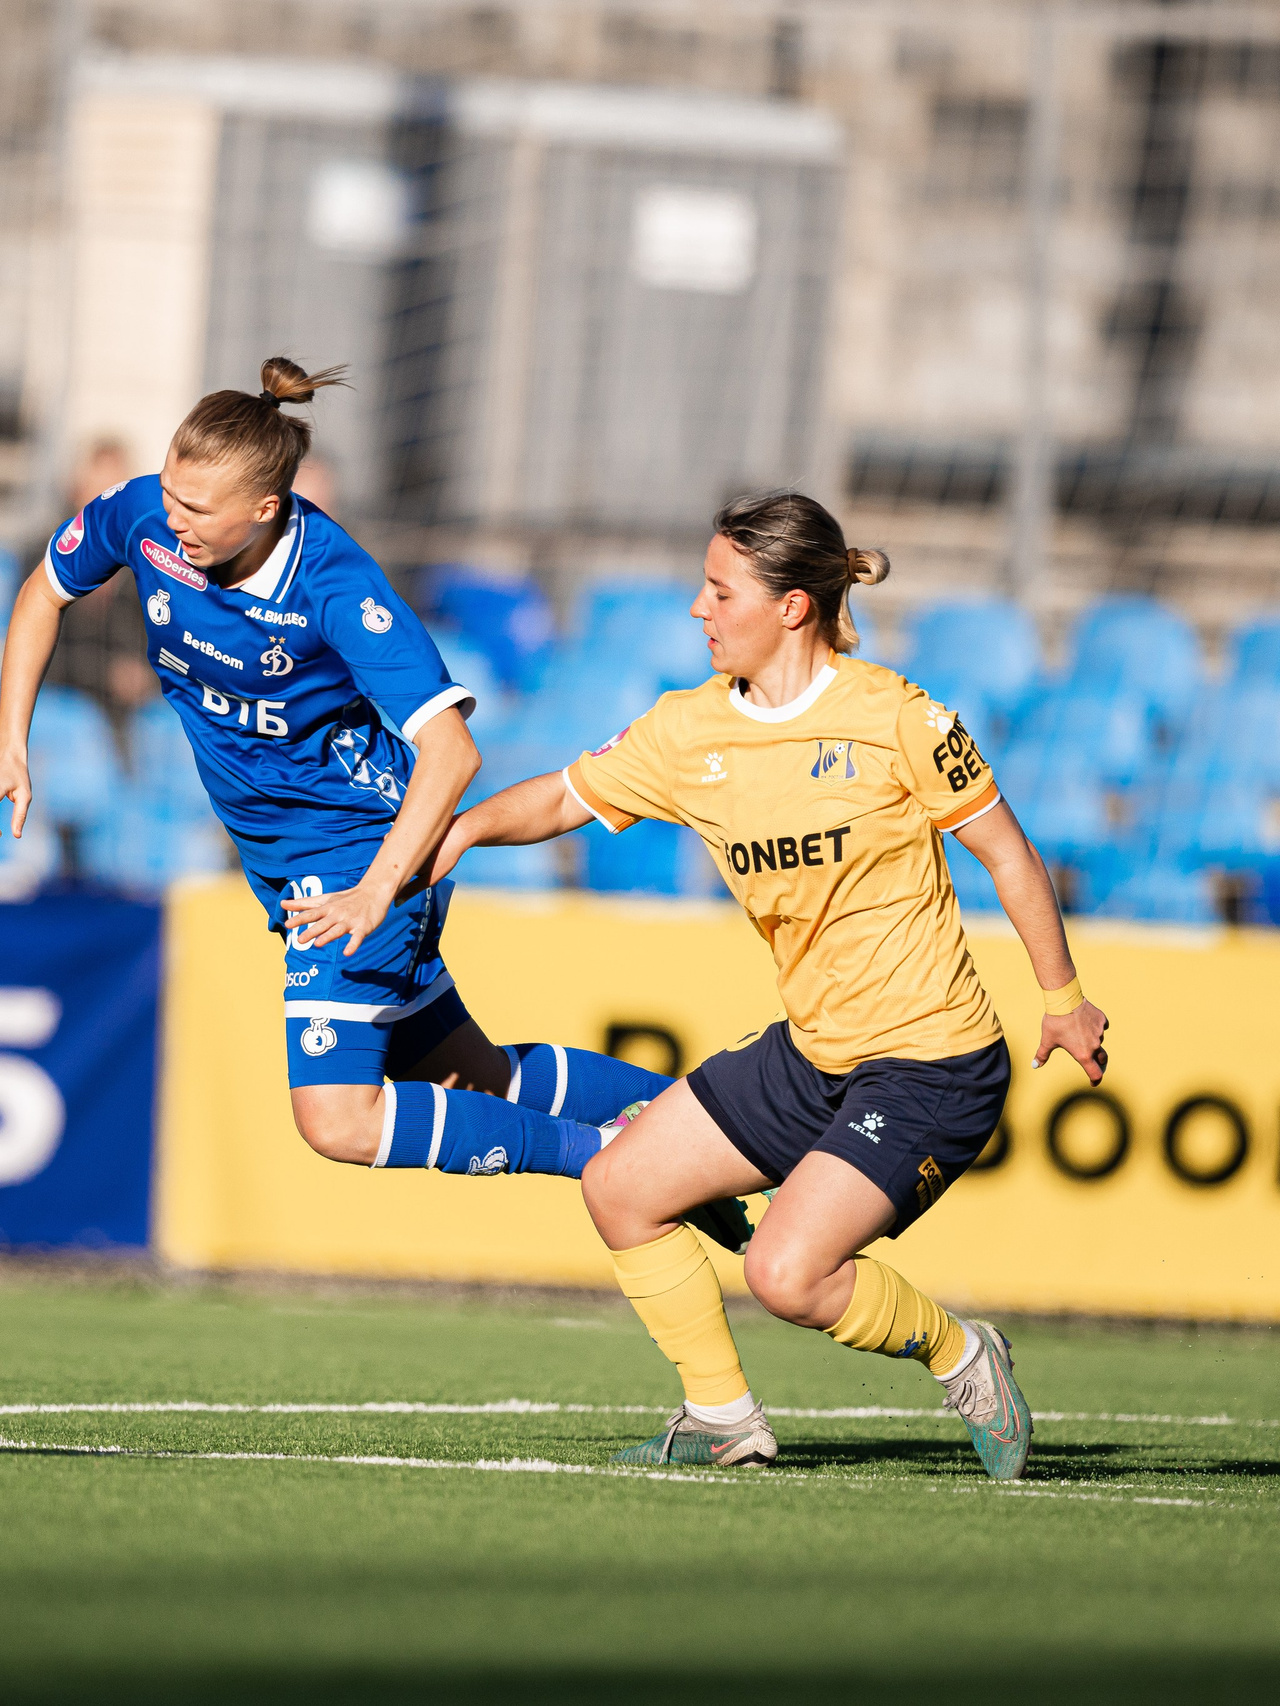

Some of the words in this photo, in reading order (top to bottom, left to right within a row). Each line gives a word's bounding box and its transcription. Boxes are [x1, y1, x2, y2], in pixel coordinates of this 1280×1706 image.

[145, 544, 205, 586] wildberries
[182, 630, 244, 671] BetBoom
[847, 1121, 882, 1144] KELME
